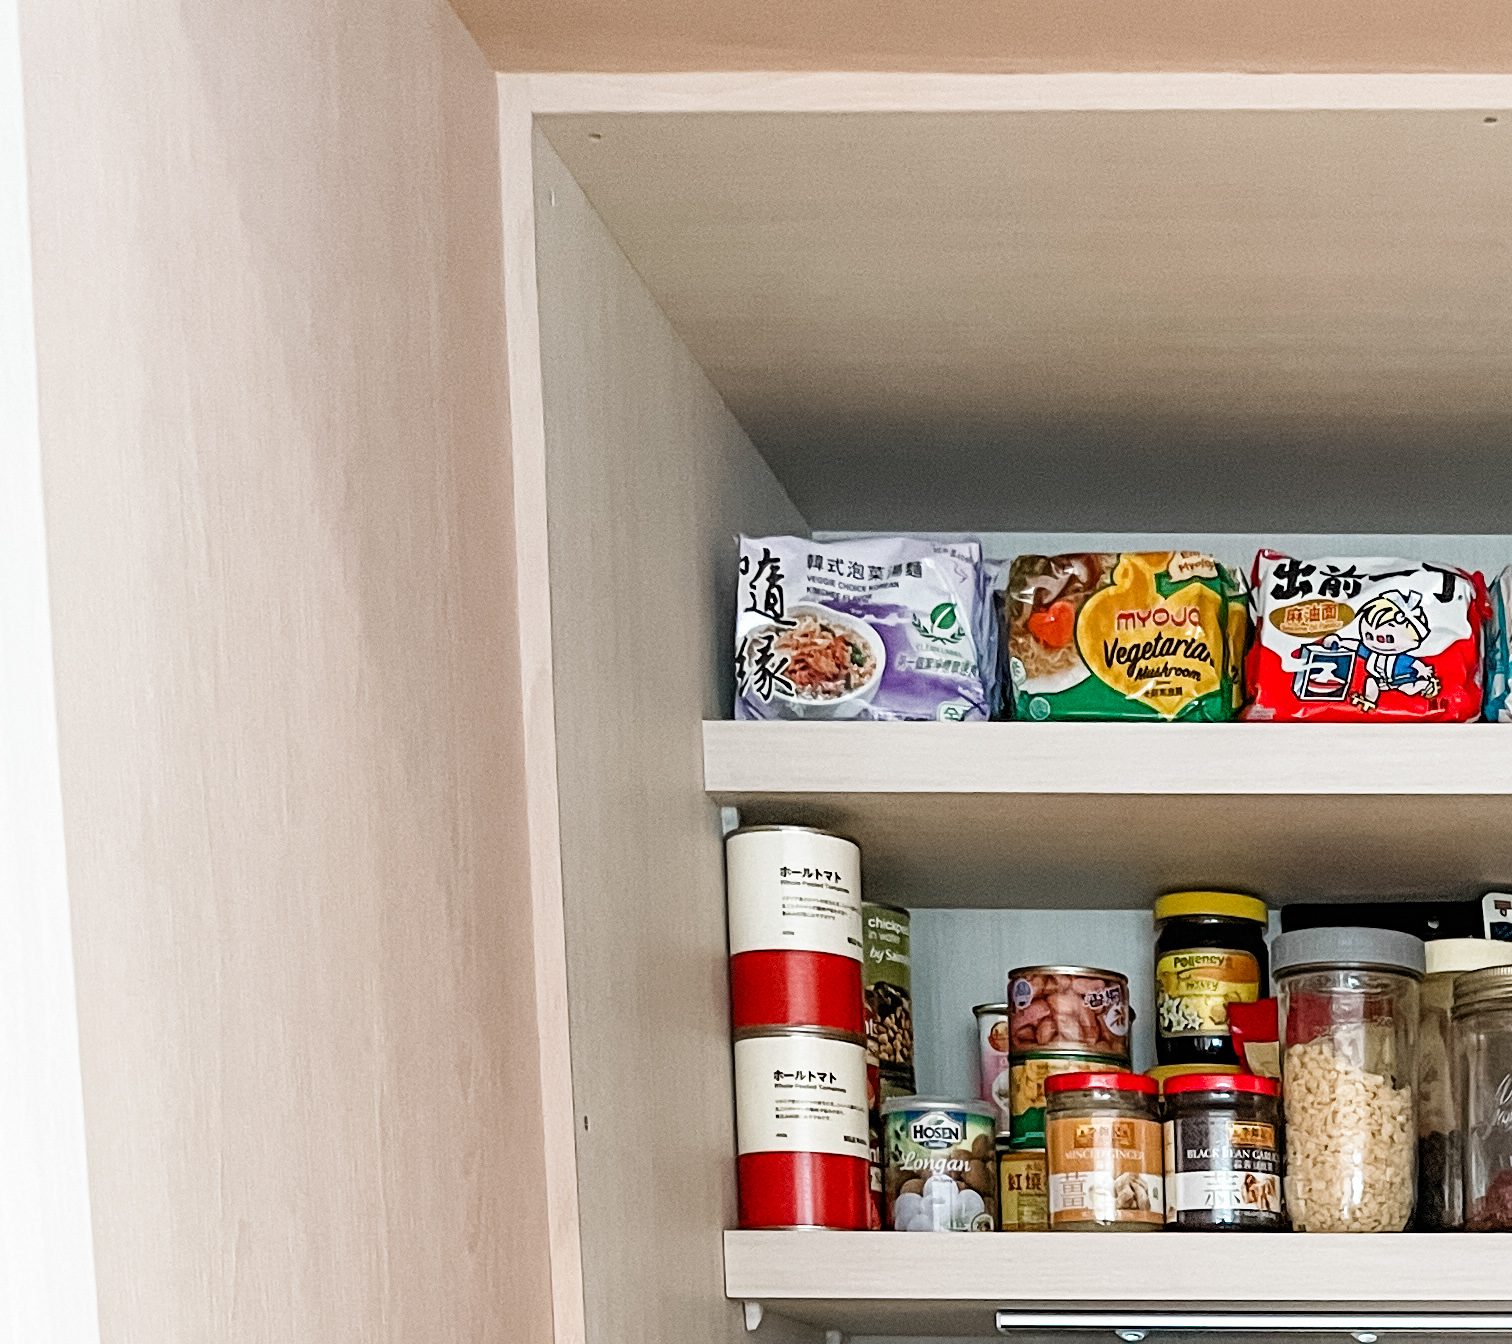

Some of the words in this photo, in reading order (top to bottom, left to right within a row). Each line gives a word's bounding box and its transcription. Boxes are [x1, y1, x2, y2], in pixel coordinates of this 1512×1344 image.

[1270, 558, 1469, 604] 出前一丁
[1135, 661, 1201, 682] Mushroom
[779, 866, 842, 883] ホールトマト
[773, 1069, 837, 1084] ホールトマト
[913, 1124, 959, 1141] HOSEN
[900, 1151, 972, 1175] Longan
